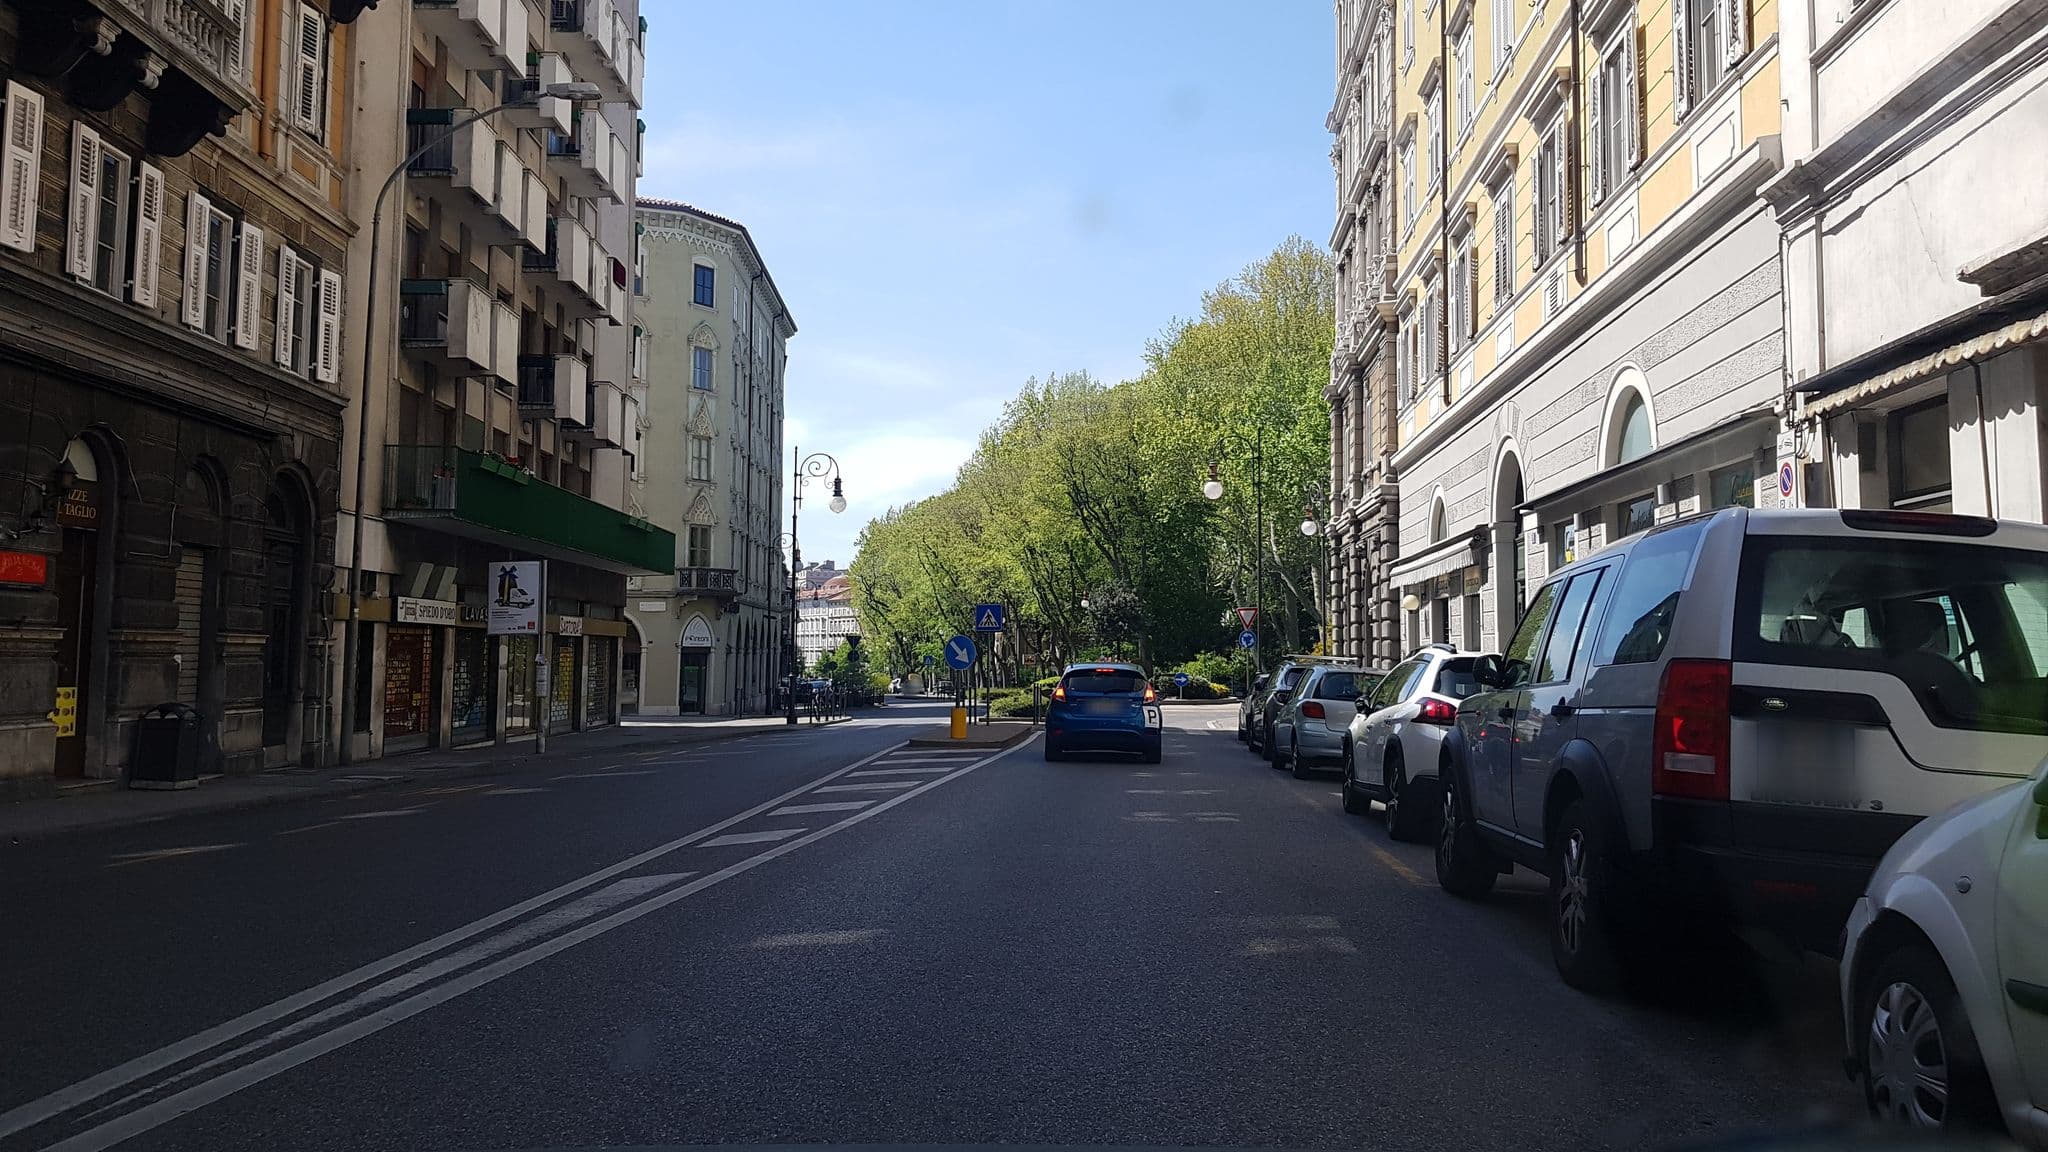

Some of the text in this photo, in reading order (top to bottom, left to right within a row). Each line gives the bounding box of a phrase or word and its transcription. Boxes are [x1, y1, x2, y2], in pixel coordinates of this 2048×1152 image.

[67, 488, 89, 503] IZZE
[64, 502, 97, 519] TAGLIO
[418, 605, 439, 619] SPIEDO
[1147, 709, 1157, 724] P
[1869, 799, 1885, 811] 3
